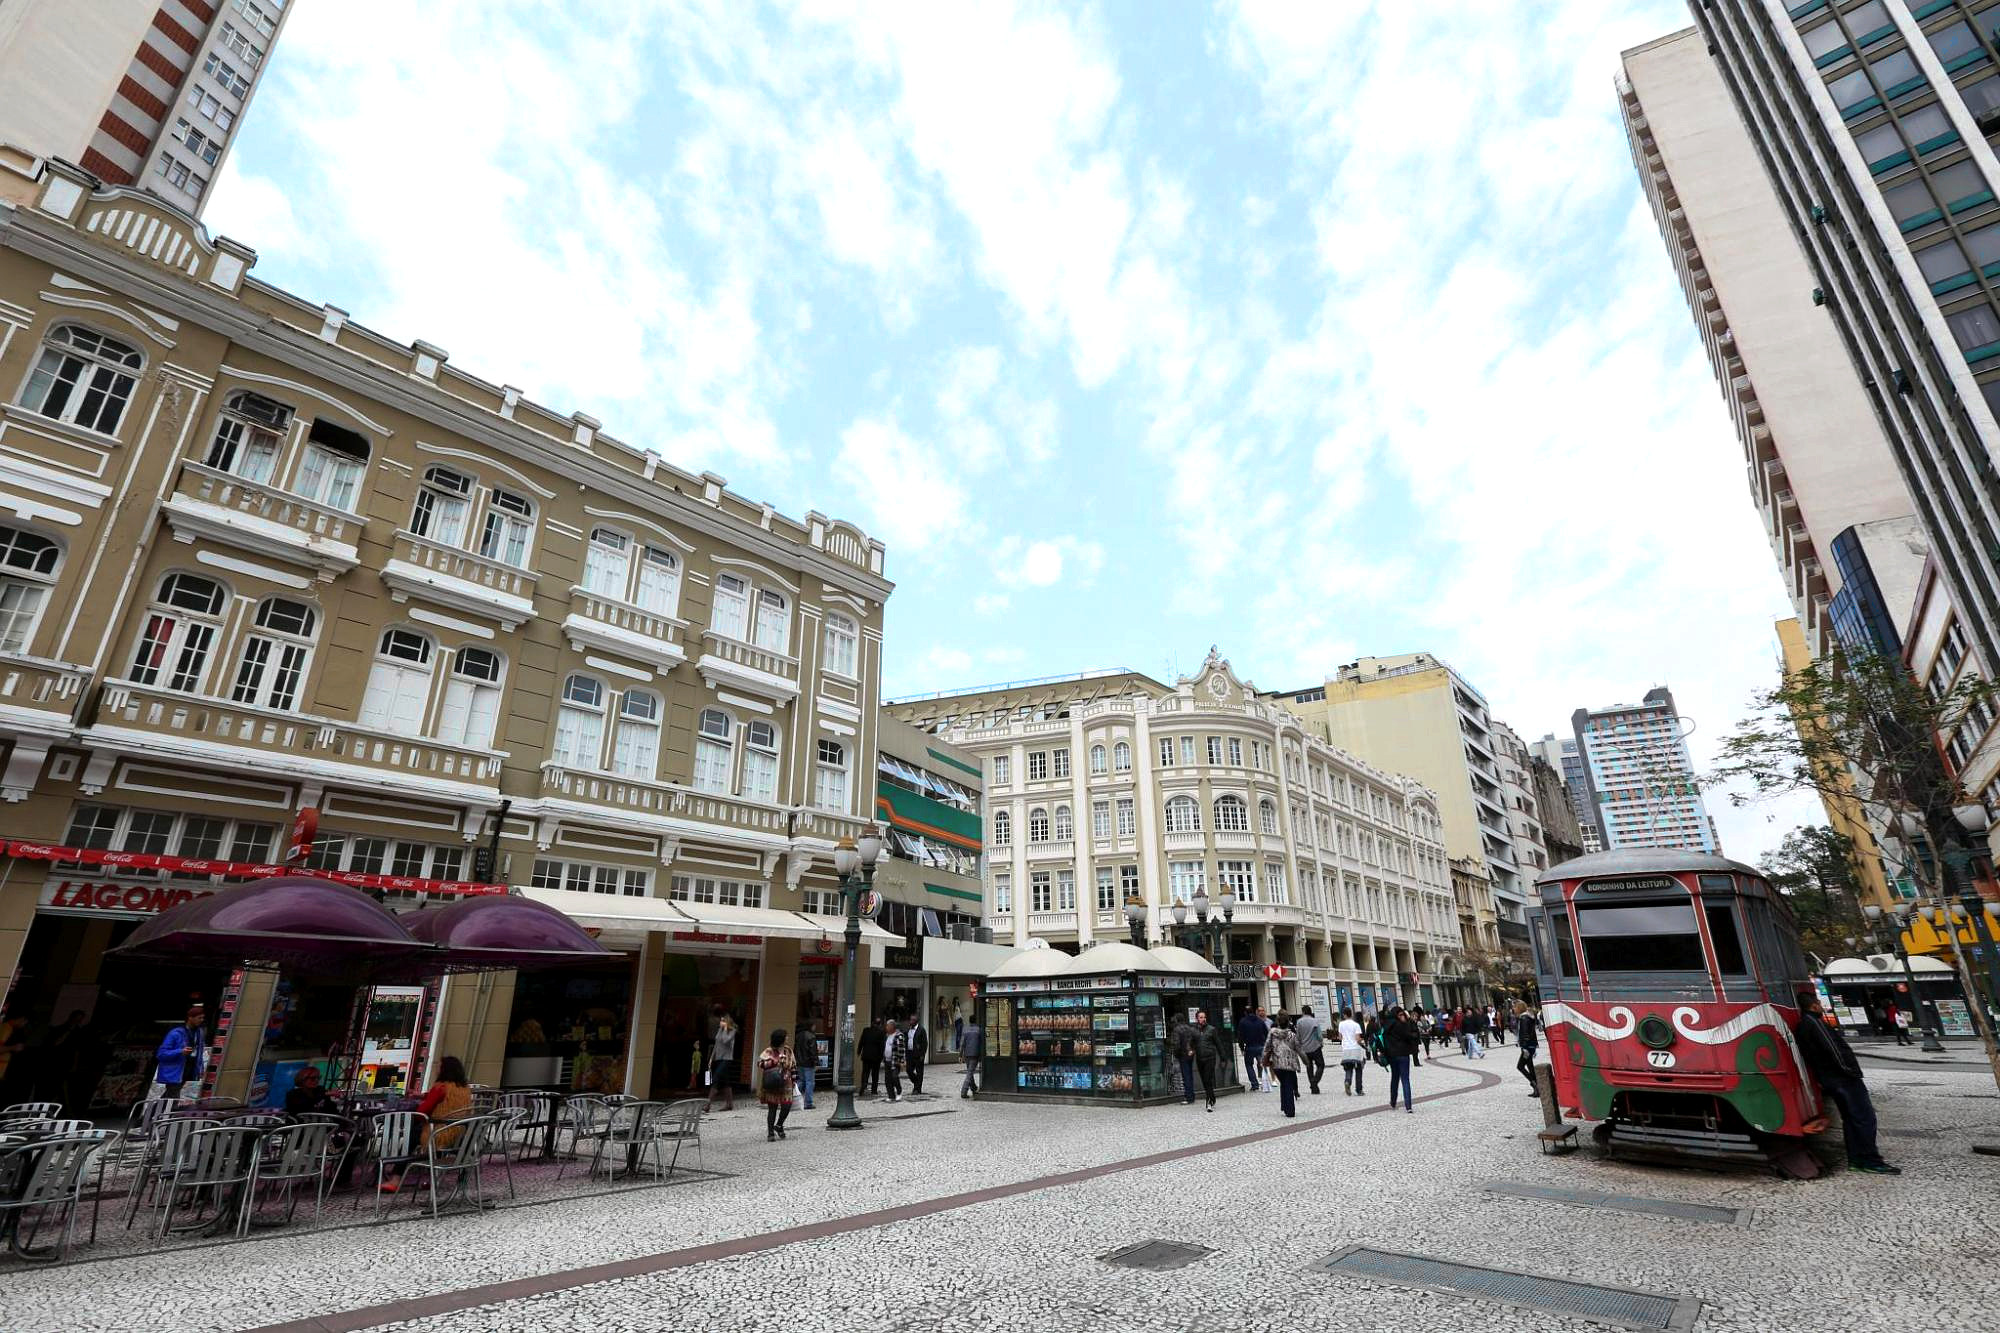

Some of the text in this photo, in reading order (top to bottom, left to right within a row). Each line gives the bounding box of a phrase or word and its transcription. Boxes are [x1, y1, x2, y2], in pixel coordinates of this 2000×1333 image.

[1626, 881, 1637, 889] DA
[1638, 879, 1671, 889] LEITURA
[1651, 1052, 1670, 1065] 77
